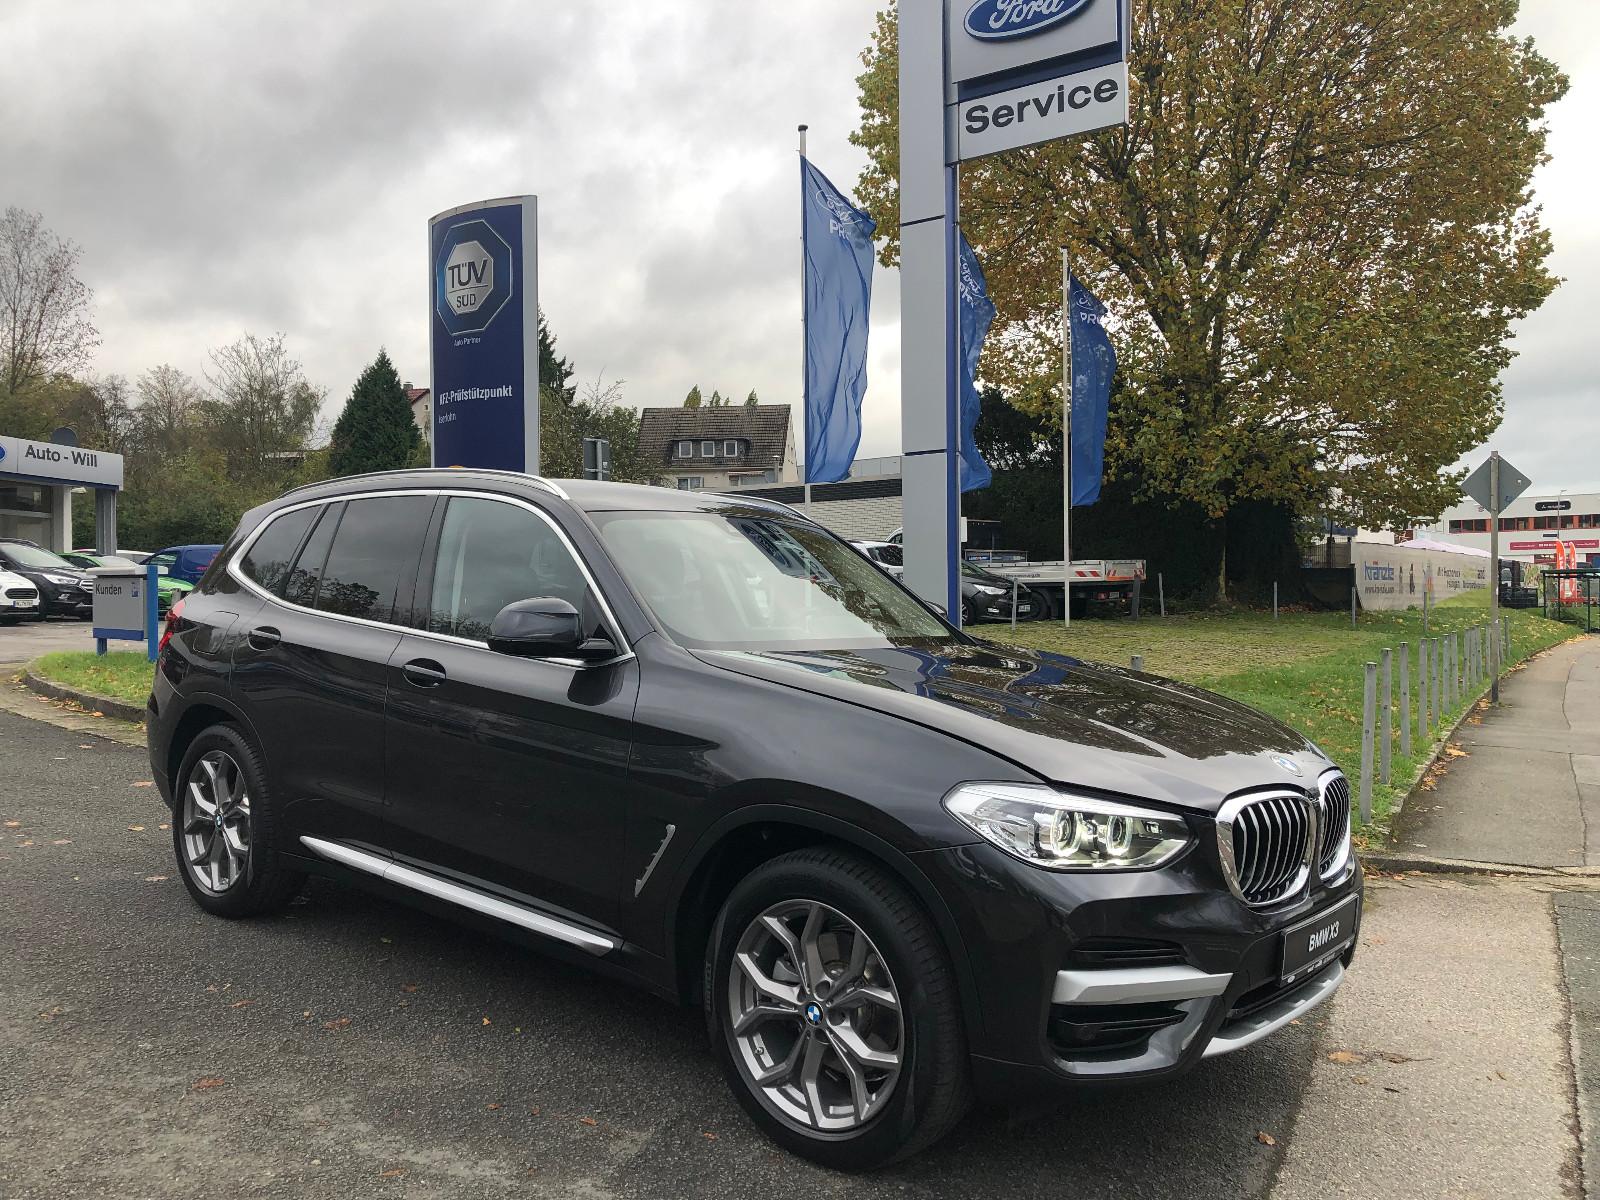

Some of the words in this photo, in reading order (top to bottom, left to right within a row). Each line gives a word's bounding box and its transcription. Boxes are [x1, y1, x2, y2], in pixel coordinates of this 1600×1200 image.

[989, 0, 1061, 29] Ford
[965, 78, 1119, 134] Service
[448, 258, 488, 288] TÜV
[25, 445, 61, 462] Auto
[71, 450, 98, 467] Will
[95, 583, 122, 596] Kunden
[1308, 925, 1330, 952] BMW
[1328, 920, 1340, 940] X3
